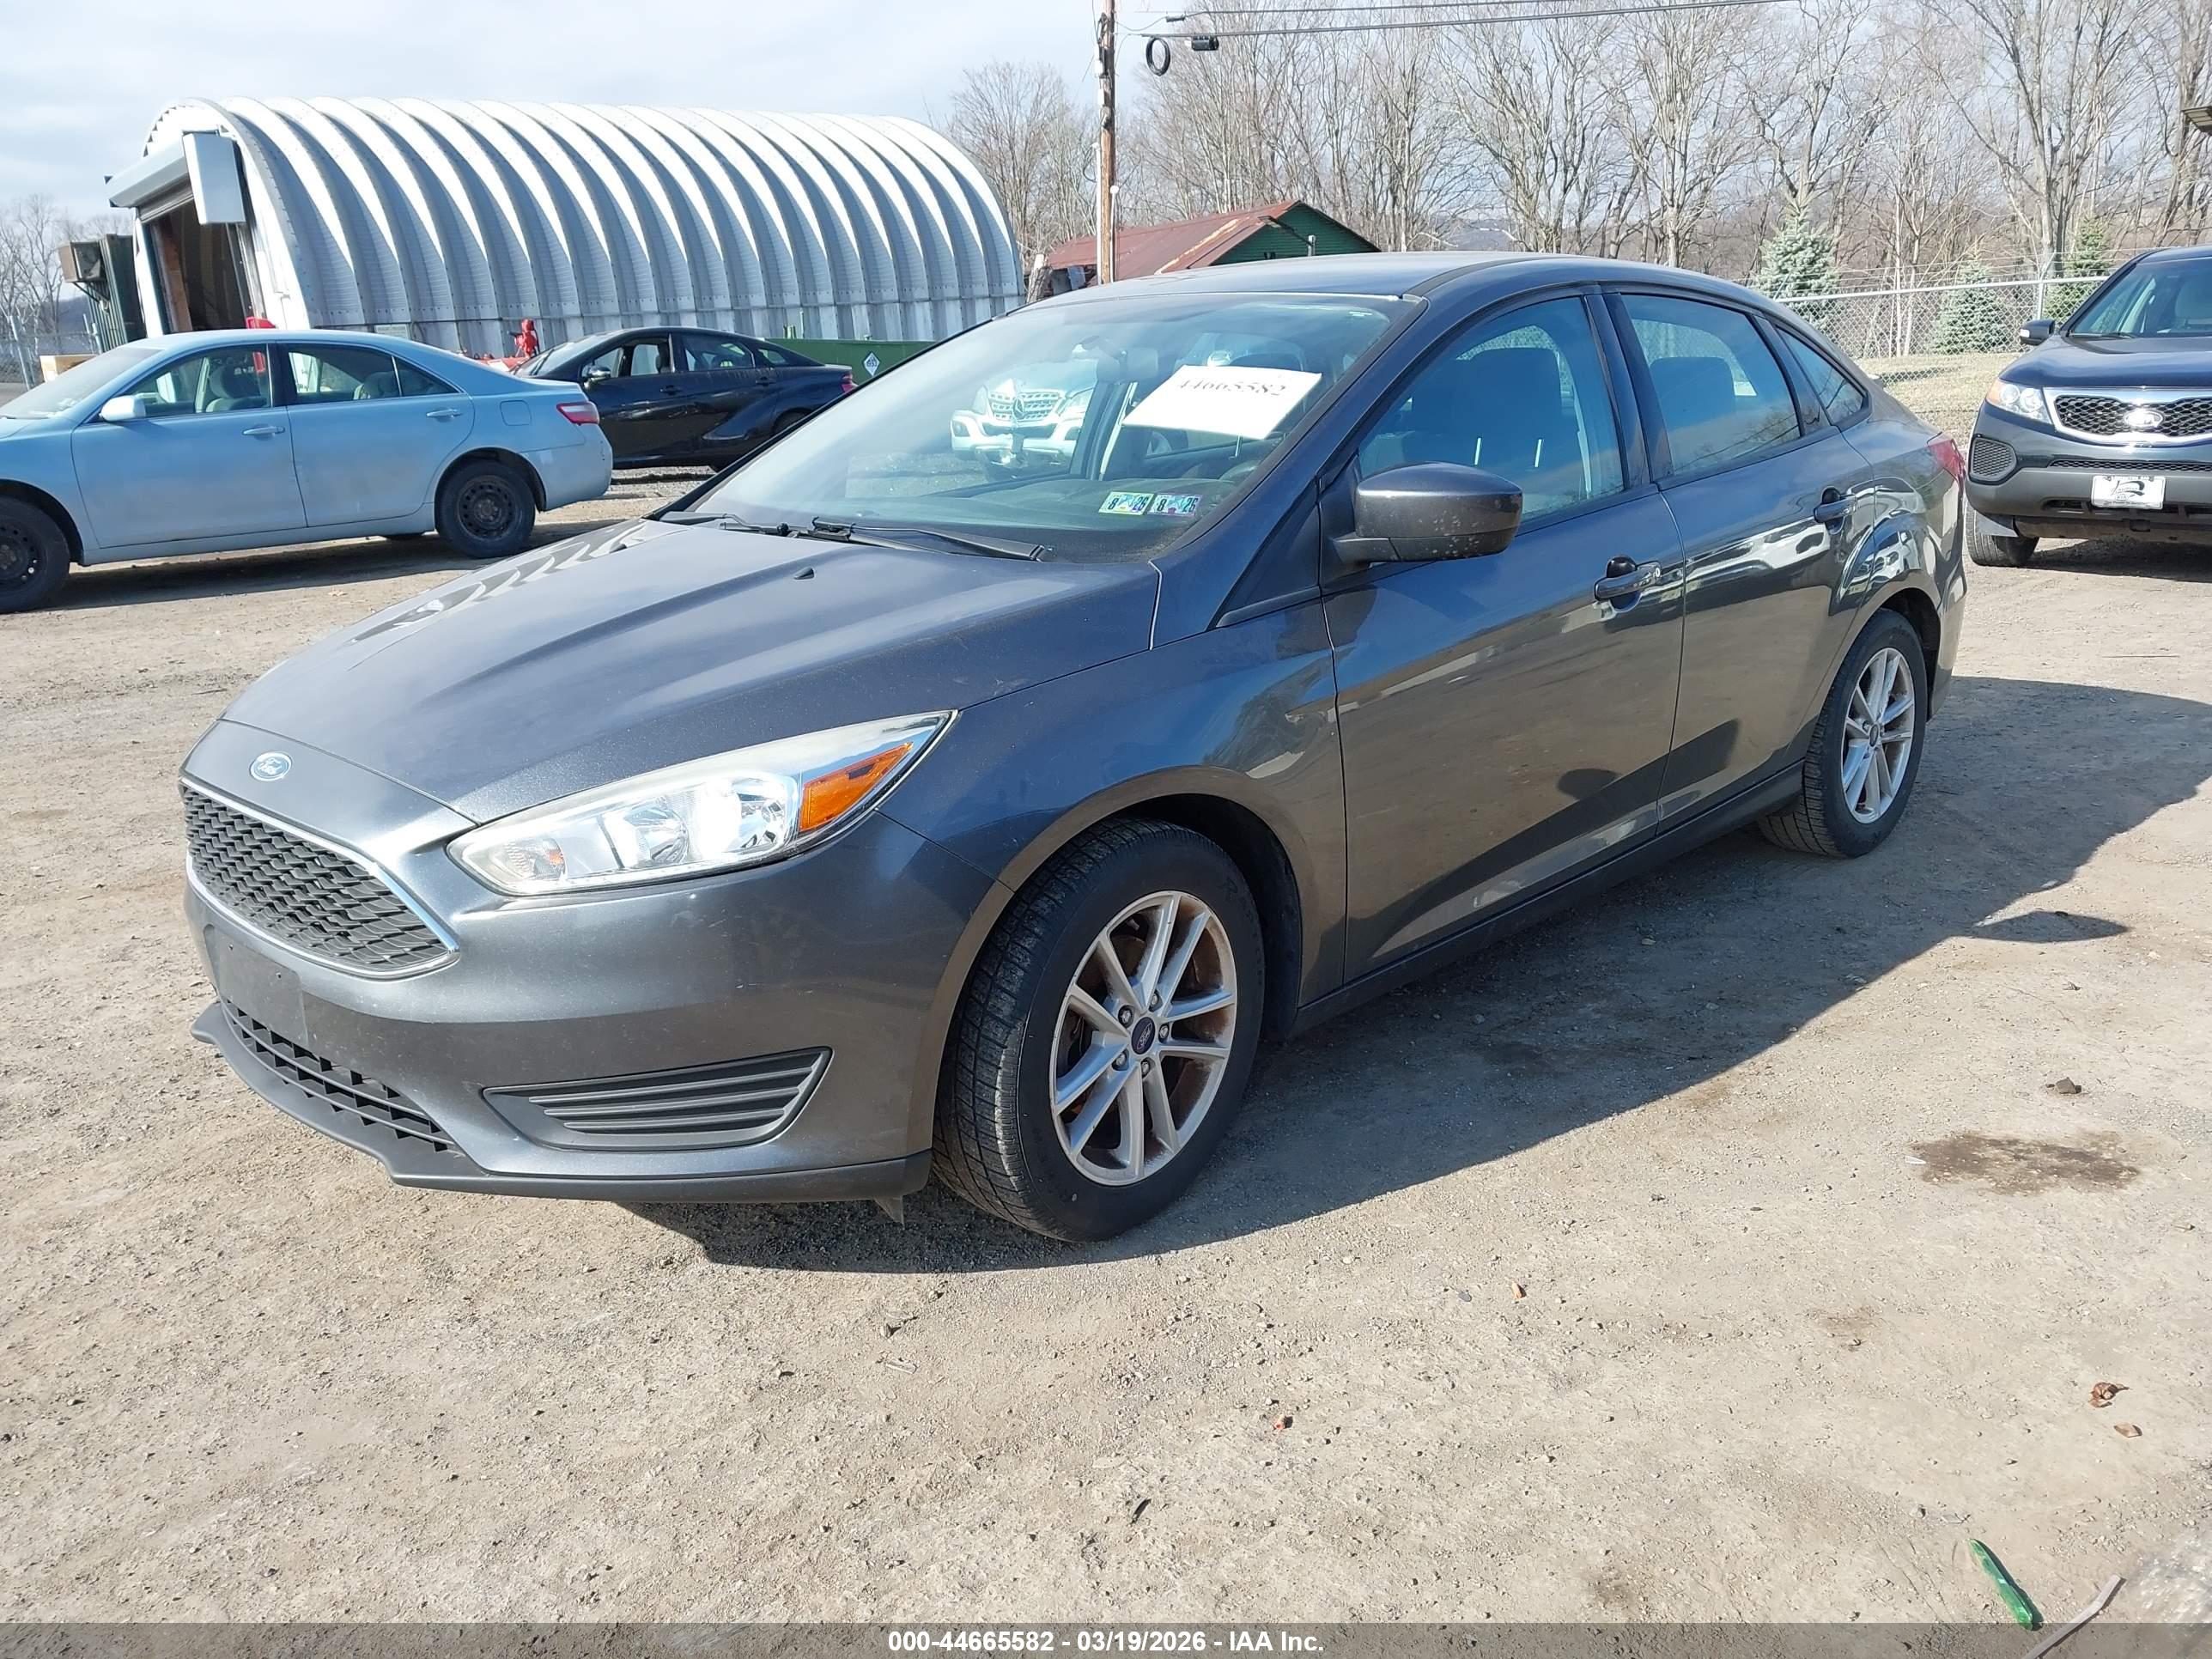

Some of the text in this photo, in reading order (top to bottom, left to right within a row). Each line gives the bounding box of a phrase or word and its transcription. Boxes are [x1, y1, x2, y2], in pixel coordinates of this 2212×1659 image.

[1108, 496, 1149, 512] 8 26
[1157, 497, 1199, 513] 8 26
